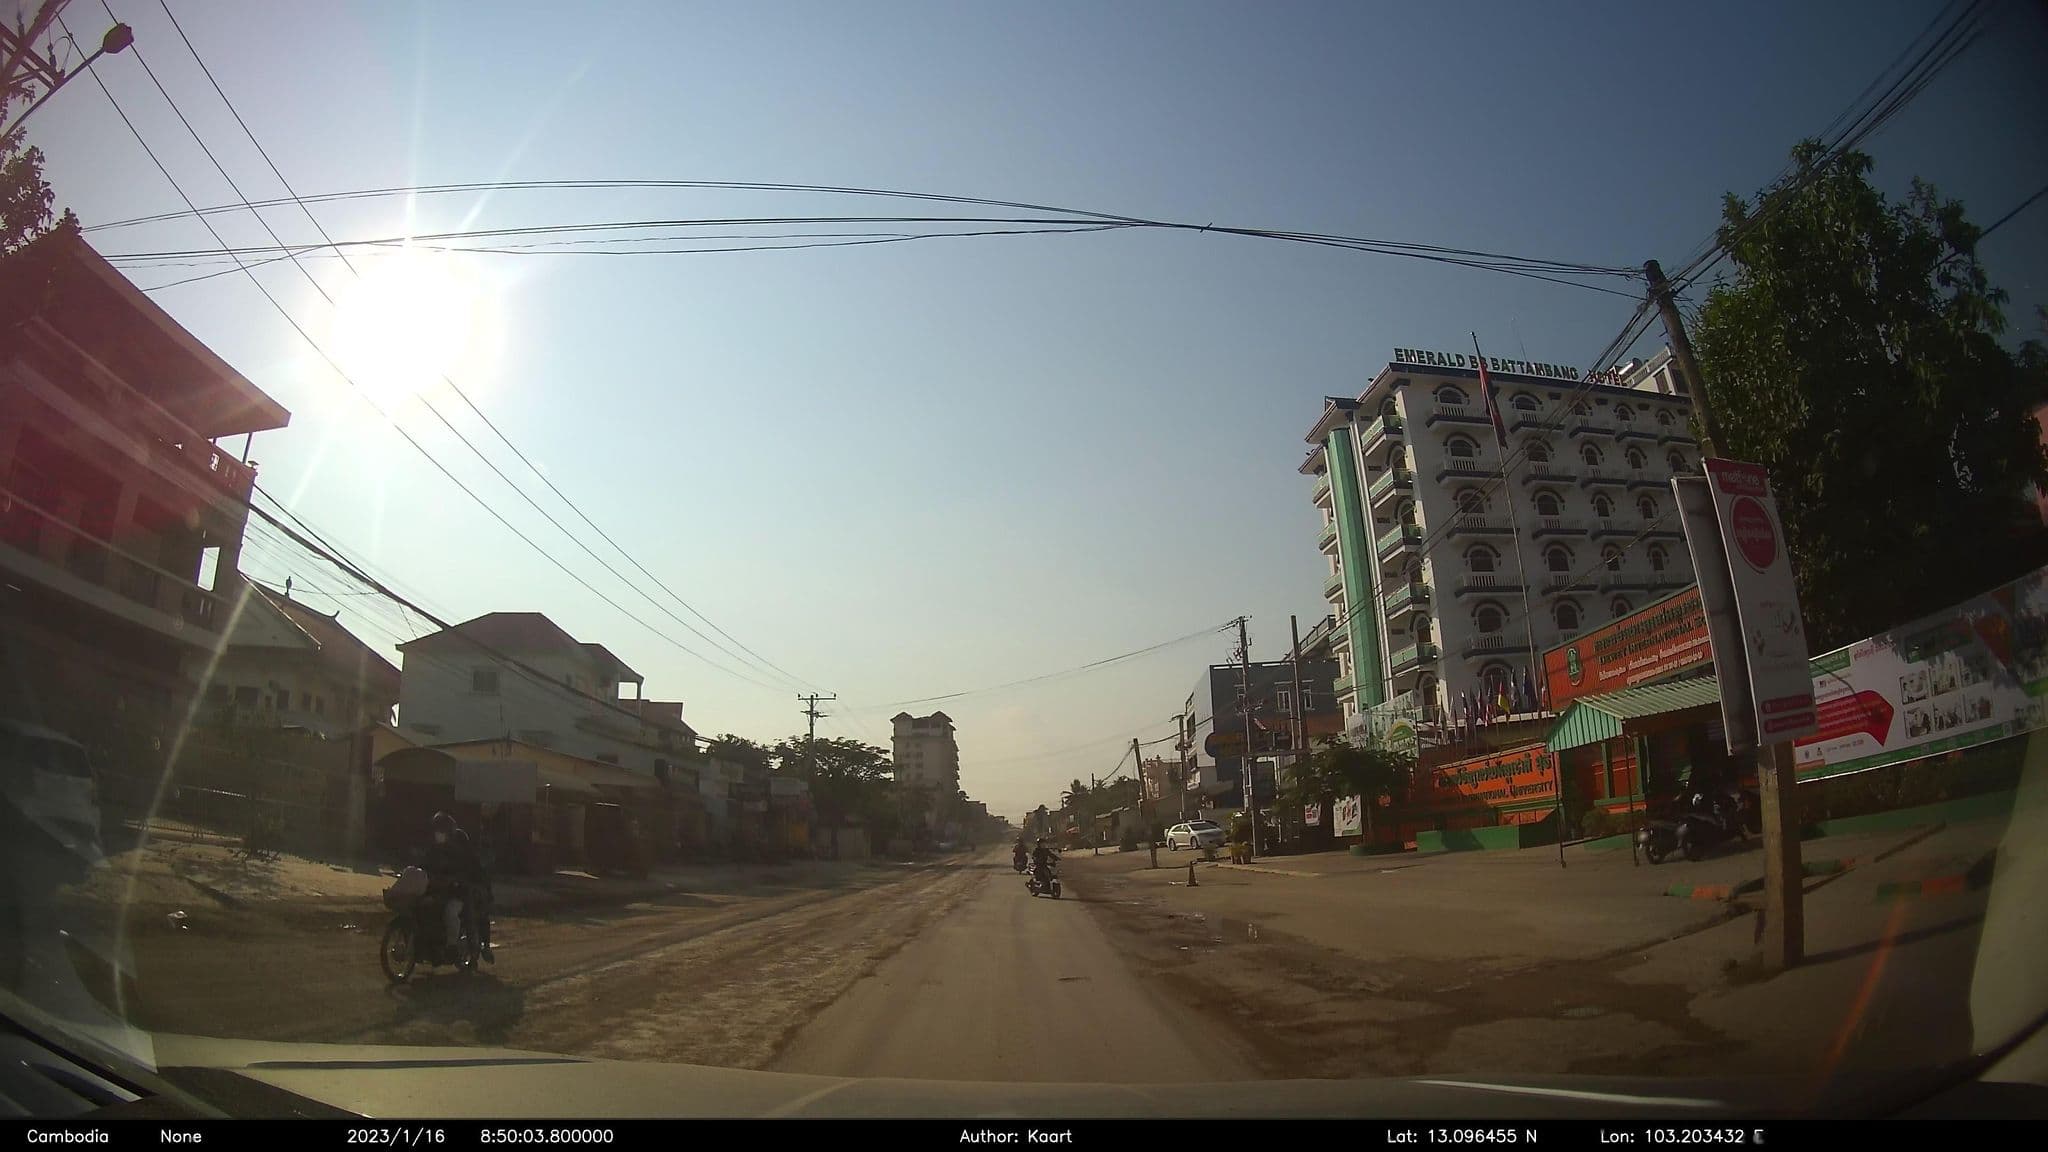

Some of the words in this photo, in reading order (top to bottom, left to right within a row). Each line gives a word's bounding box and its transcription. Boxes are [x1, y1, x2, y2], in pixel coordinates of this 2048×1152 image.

[1394, 347, 1466, 368] EMERALD
[1490, 357, 1579, 381] BATTAMBANG
[1510, 780, 1553, 798] UNIVERSITY
